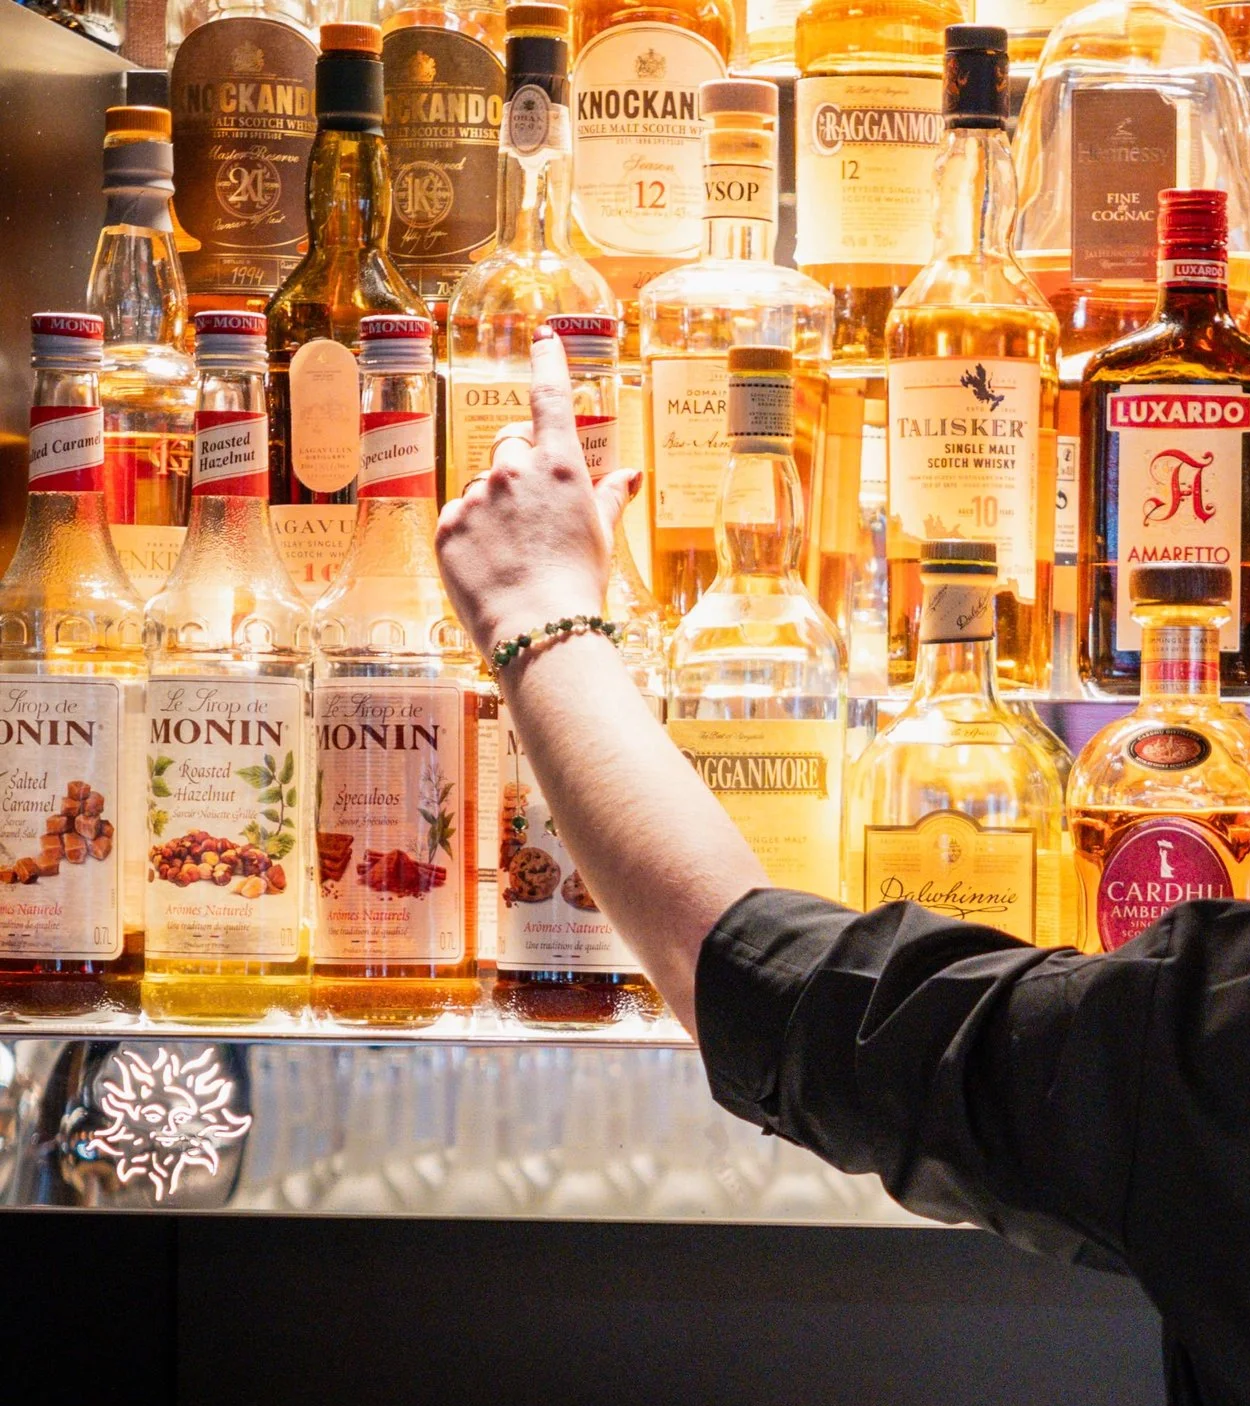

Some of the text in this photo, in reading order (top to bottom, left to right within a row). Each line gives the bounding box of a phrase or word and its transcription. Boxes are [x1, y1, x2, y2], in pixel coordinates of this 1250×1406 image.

[239, 119, 318, 132] SCOTCH WHIS
[412, 127, 456, 137] SCOTCH
[578, 124, 608, 134] SINGLE
[608, 123, 641, 134] MALT
[642, 123, 686, 135] SCOTCH
[1077, 143, 1170, 166] Hennessy
[842, 160, 860, 180] 12
[635, 180, 666, 209] 12
[704, 181, 760, 203] VSOP
[1107, 193, 1141, 205] FINE
[1091, 210, 1155, 222] COGNAC
[231, 266, 264, 286] 1994
[1175, 265, 1224, 278] LUXARDO
[51, 318, 102, 334] MONIN
[213, 316, 266, 330] MONIN
[367, 321, 425, 334] MONIN
[466, 388, 531, 407] OBA
[1116, 401, 1245, 423] LUXARDO
[897, 417, 1027, 439] TALISKER
[51, 433, 101, 454] Caramel
[201, 432, 250, 453] Roasted
[944, 443, 1016, 455] SINGLE MALT
[199, 449, 255, 472] Hazelnut
[361, 443, 419, 470] Speculoos
[927, 457, 1016, 469] SCOTCH WHISKY
[971, 495, 998, 528] 10
[307, 540, 343, 548] SINGLE
[1127, 546, 1231, 563] AMARETTO
[3, 687, 77, 718] Sirop de
[161, 688, 268, 719] Le Sirop de
[321, 692, 423, 723] Le Sirop de
[150, 718, 284, 747] MONIN
[8, 768, 48, 790] Salted
[179, 758, 231, 784] Roasted
[2, 790, 56, 813] Caramel
[174, 782, 236, 803] Hazelnut
[333, 784, 400, 811] Speculoos
[879, 875, 1019, 905] Dalwhinnie
[1107, 881, 1224, 903] CARDHU
[17, 902, 63, 916] Naturels
[205, 902, 254, 918] Naturels
[362, 906, 410, 921] Naturels
[523, 921, 613, 934] Arômes Naturels
[524, 940, 539, 951] Une
[539, 940, 574, 952] tradition
[574, 941, 584, 951] de
